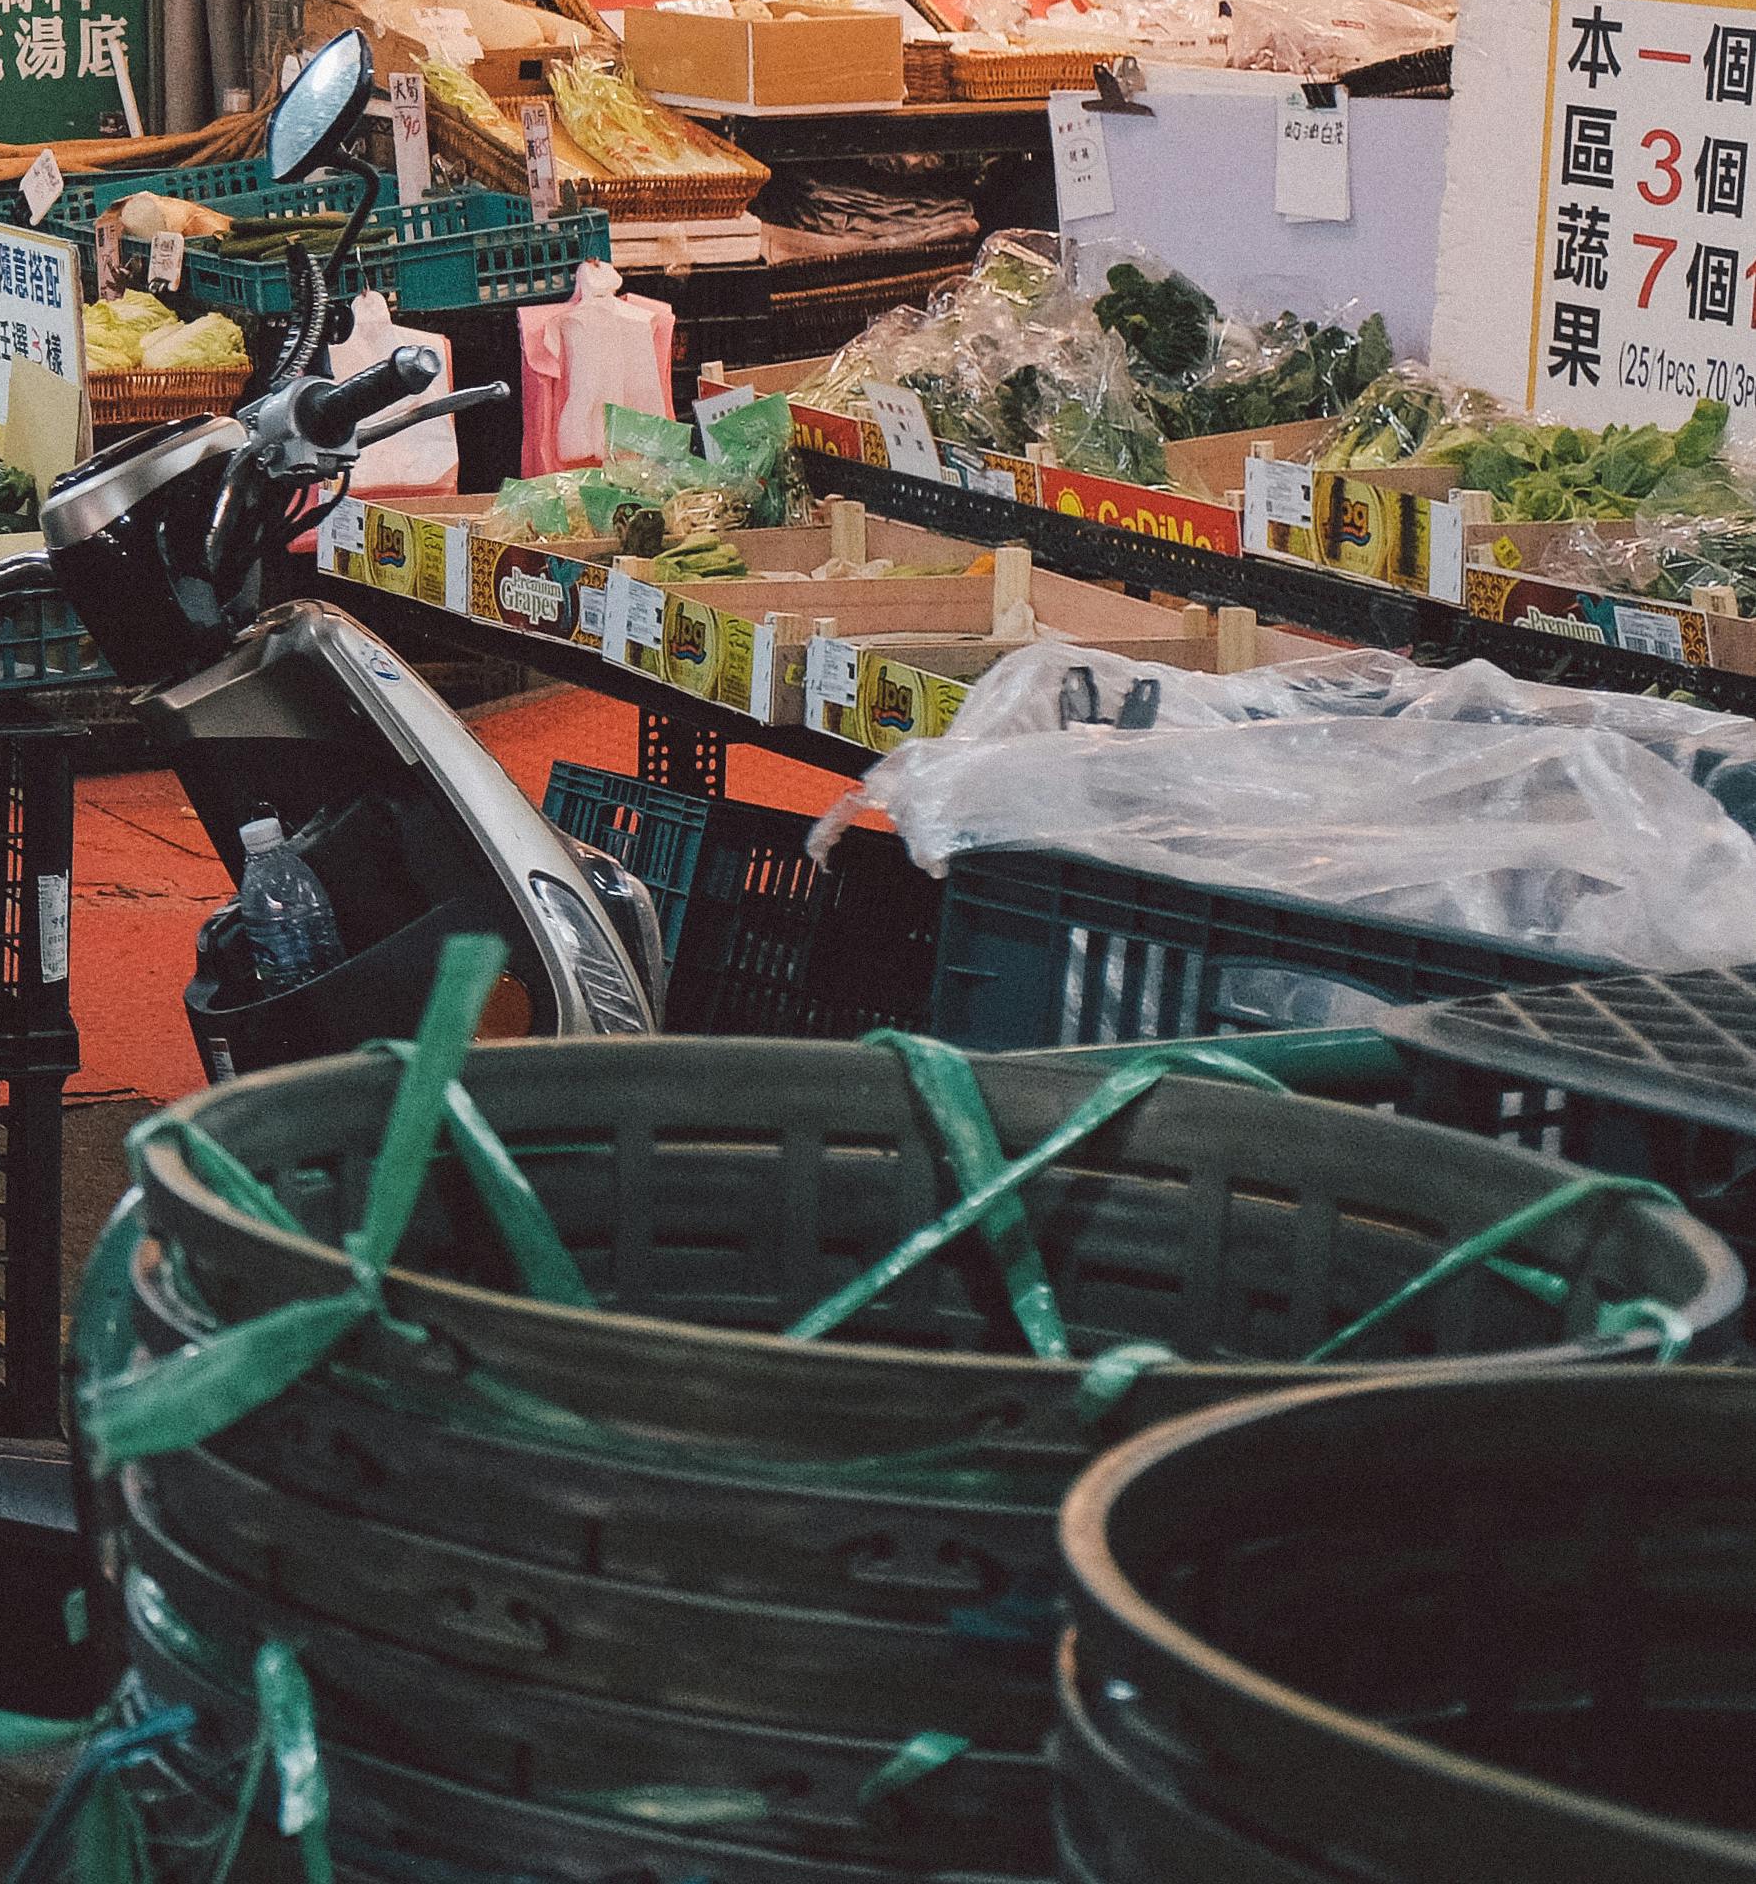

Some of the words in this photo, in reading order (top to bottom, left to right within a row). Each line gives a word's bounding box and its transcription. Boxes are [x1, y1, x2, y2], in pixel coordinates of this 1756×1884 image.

[402, 118, 420, 142] 90
[1547, 5, 1624, 387] 本區蔬果
[1636, 129, 1749, 219] 3個
[502, 578, 560, 623] Grapes
[513, 567, 563, 599] Premium
